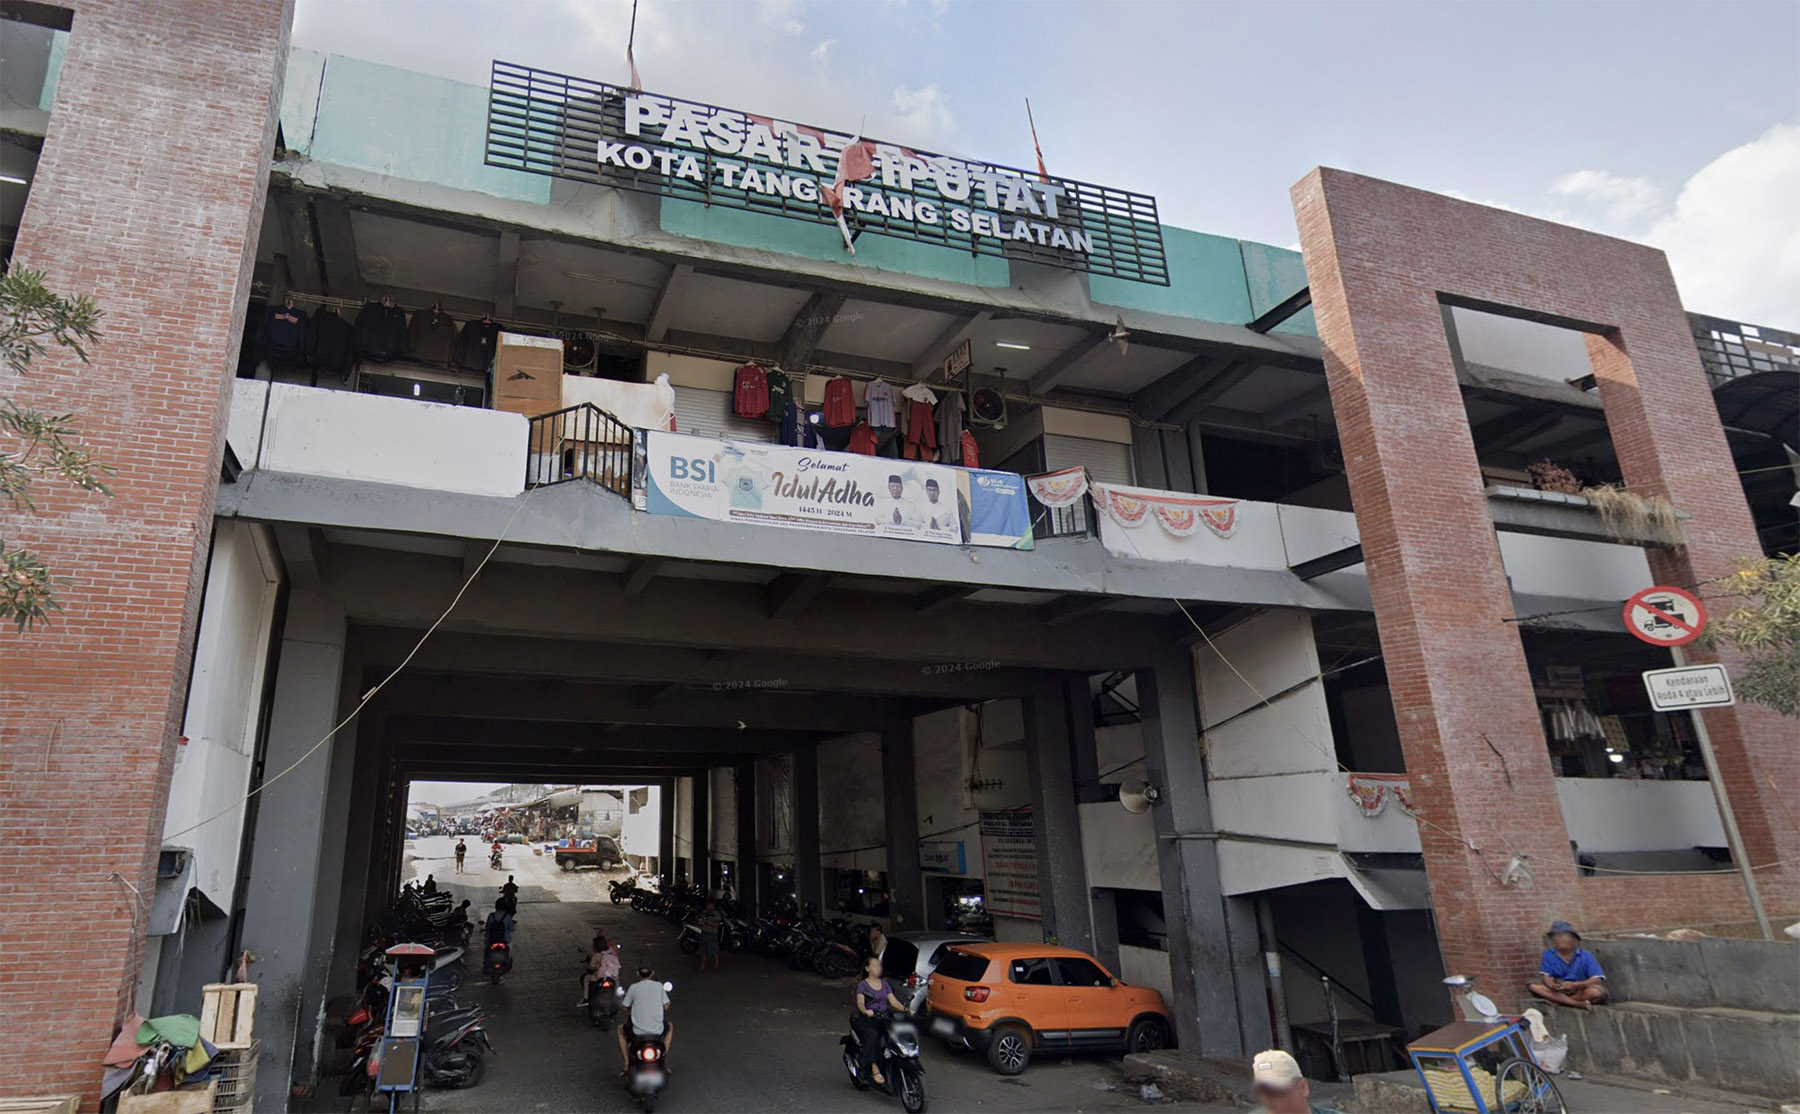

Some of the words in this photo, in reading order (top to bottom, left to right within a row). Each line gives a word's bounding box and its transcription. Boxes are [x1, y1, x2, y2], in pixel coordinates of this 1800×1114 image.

[624, 95, 828, 173] PASAR
[848, 146, 1066, 219] IPUTAT
[597, 140, 703, 182] KOTA
[716, 162, 938, 224] TANGRANG
[950, 207, 1094, 253] SELATAN
[670, 455, 715, 483] BSI
[797, 457, 850, 472] Selamat
[670, 480, 691, 489] BANK
[670, 488, 712, 498] INDONESIA
[827, 509, 845, 517] 2024
[1666, 676, 1709, 687] Kendaraan
